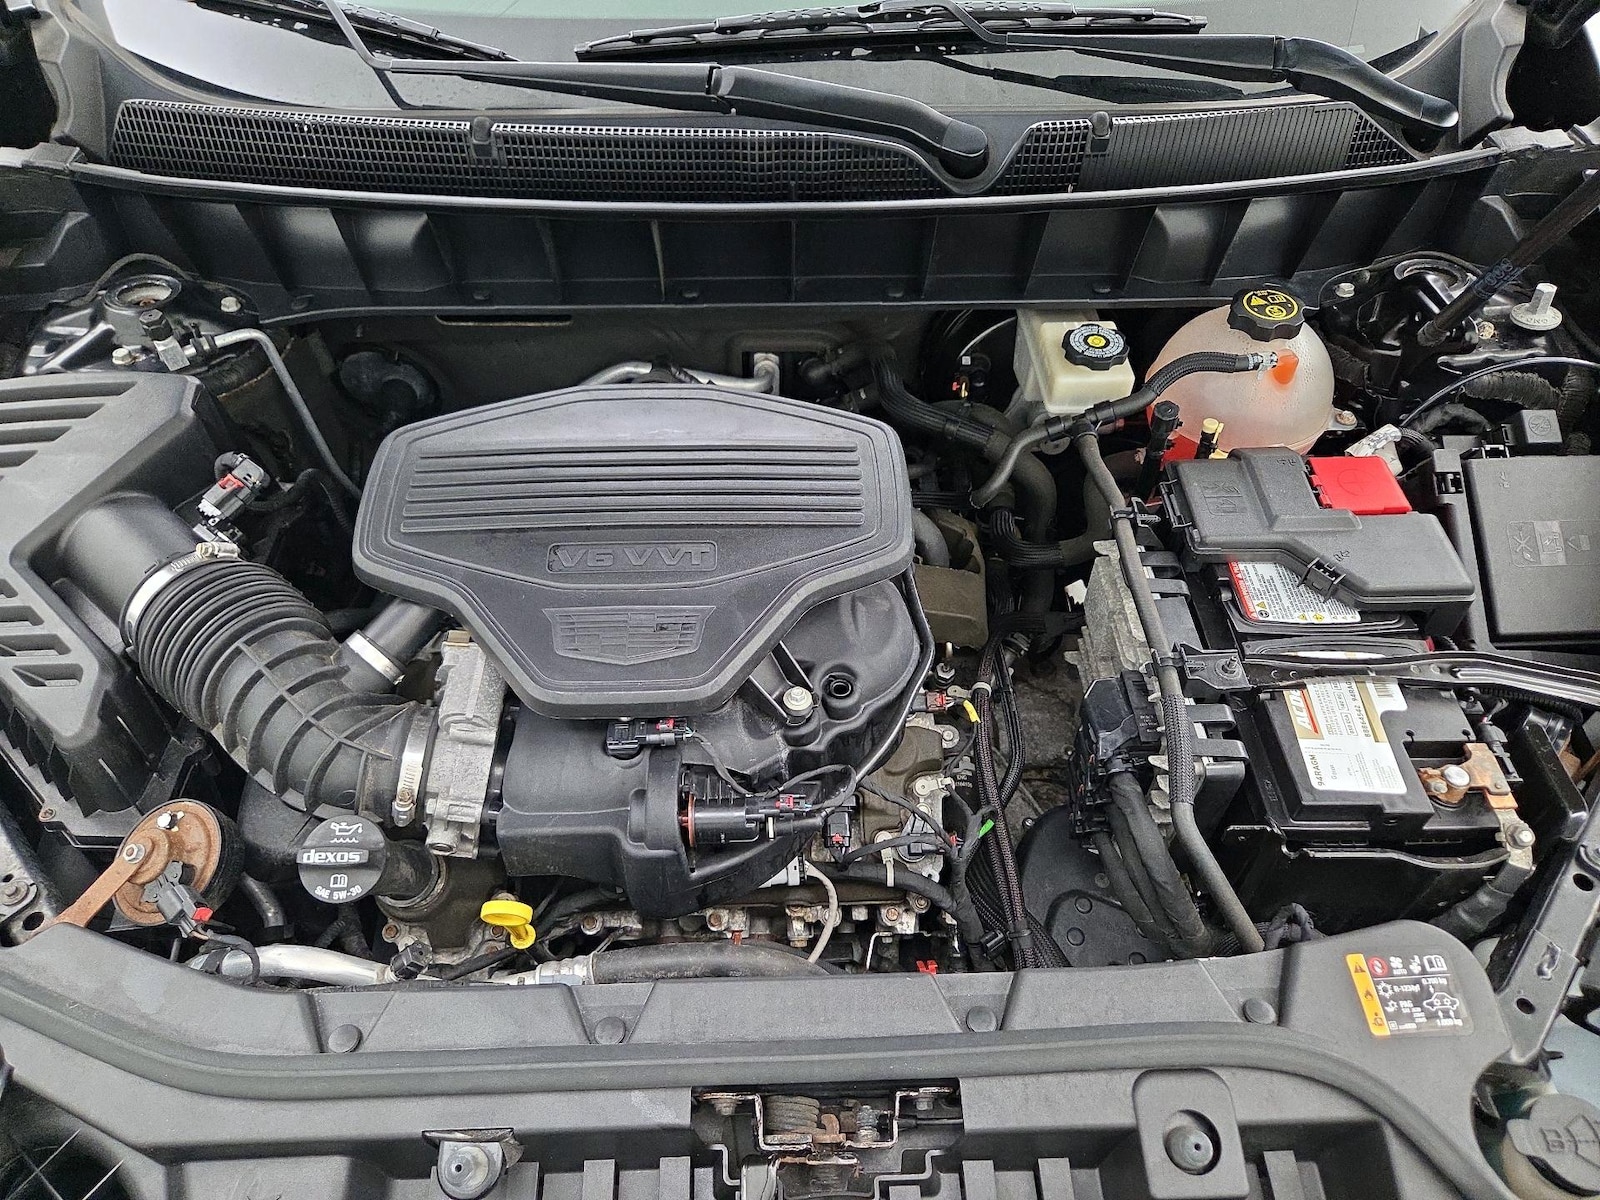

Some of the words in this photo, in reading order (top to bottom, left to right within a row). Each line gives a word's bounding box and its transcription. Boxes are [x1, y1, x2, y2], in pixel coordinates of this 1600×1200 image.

[555, 547, 614, 568] V6
[623, 544, 711, 567] VVT
[1308, 754, 1325, 786] 94RAGM
[303, 849, 361, 863] dexos
[315, 885, 331, 899] SAE
[333, 885, 362, 899] 5W-30
